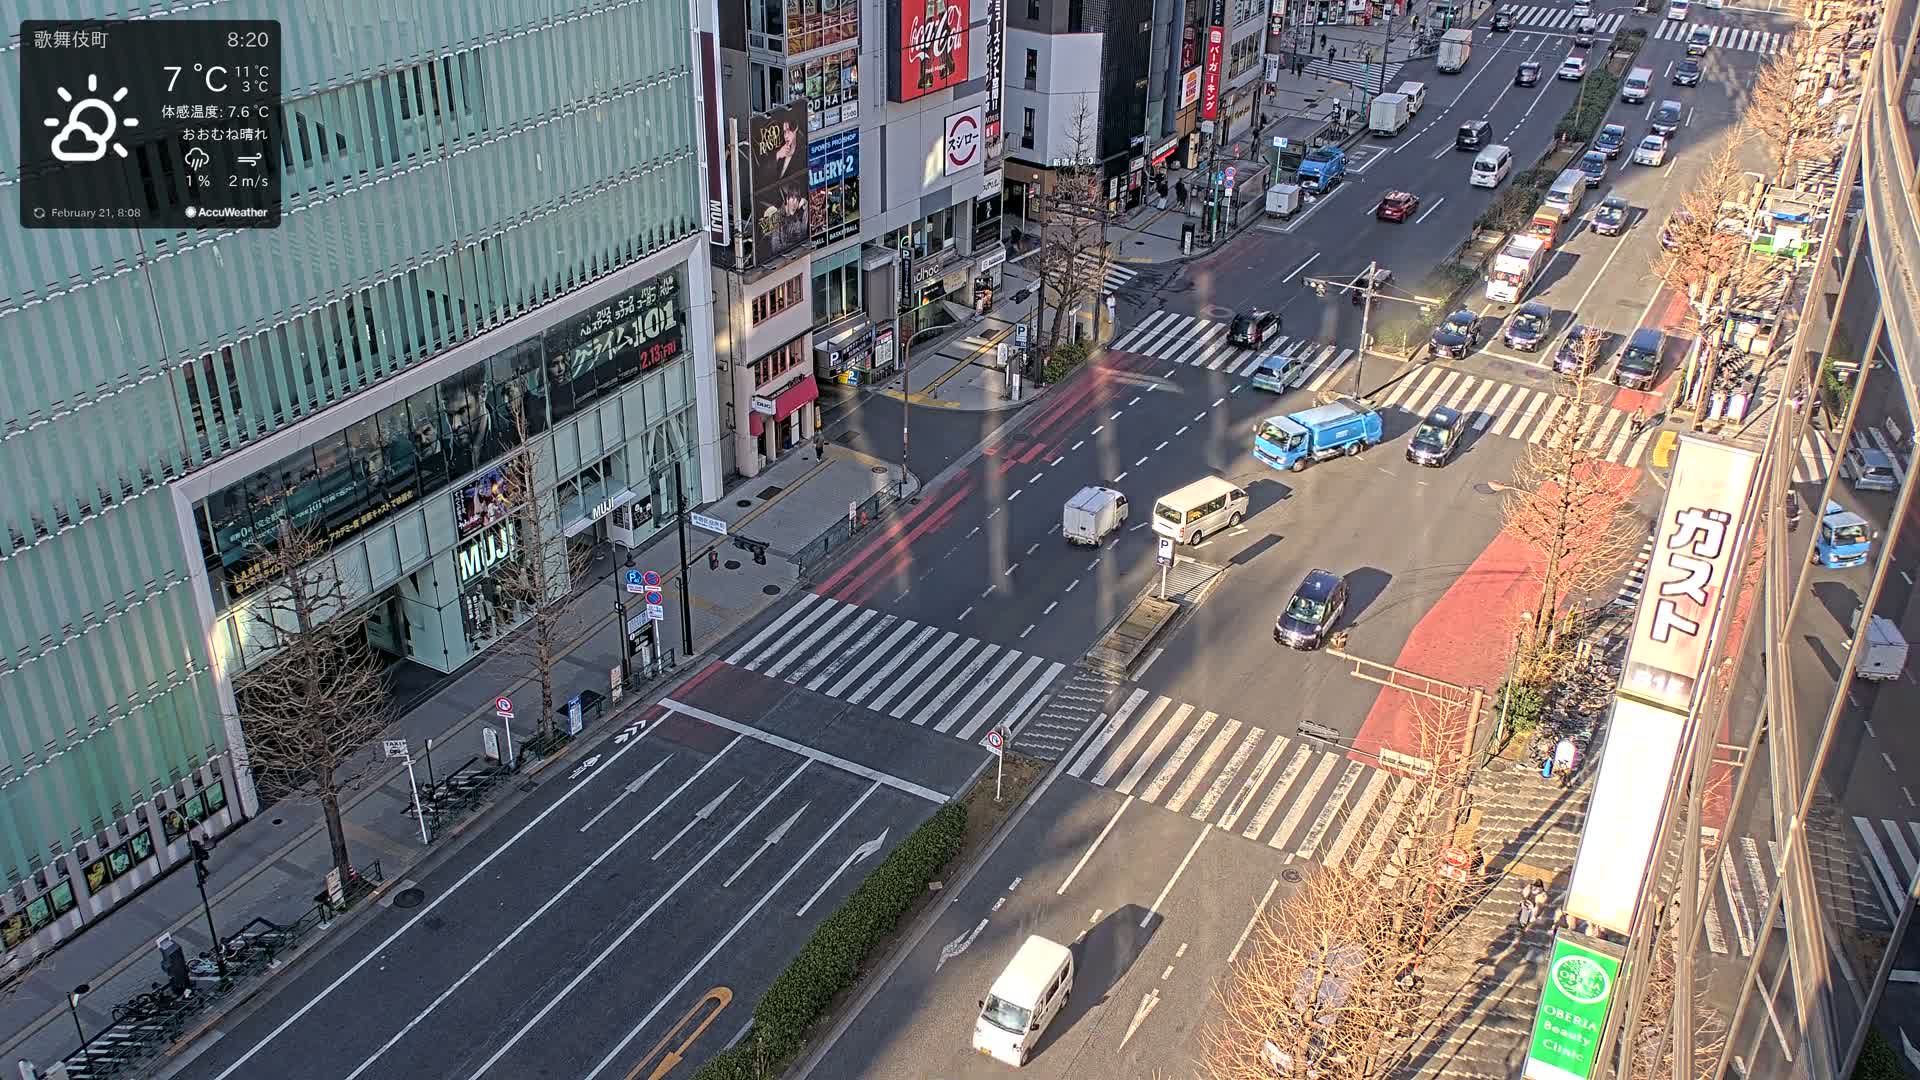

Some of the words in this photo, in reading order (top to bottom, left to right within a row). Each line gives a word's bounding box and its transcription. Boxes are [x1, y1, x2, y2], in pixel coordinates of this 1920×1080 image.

[1206, 46, 1219, 110] バーガーキング
[811, 141, 832, 154] SPORTS
[843, 133, 857, 144] SHOP
[948, 133, 979, 152] スシロー
[710, 200, 722, 233] MUJI
[829, 224, 858, 240] BASKETBALL
[1018, 326, 1025, 335] P
[831, 352, 840, 367] P
[593, 497, 614, 519] MUJI
[459, 523, 515, 581] MUJI
[1161, 540, 1168, 548] P
[629, 573, 636, 583] P
[1650, 507, 1731, 643] ガスト
[1543, 1004, 1599, 1033] OBERIA
[1543, 1020, 1592, 1047] Beauty
[1542, 1039, 1585, 1062] Clinic
